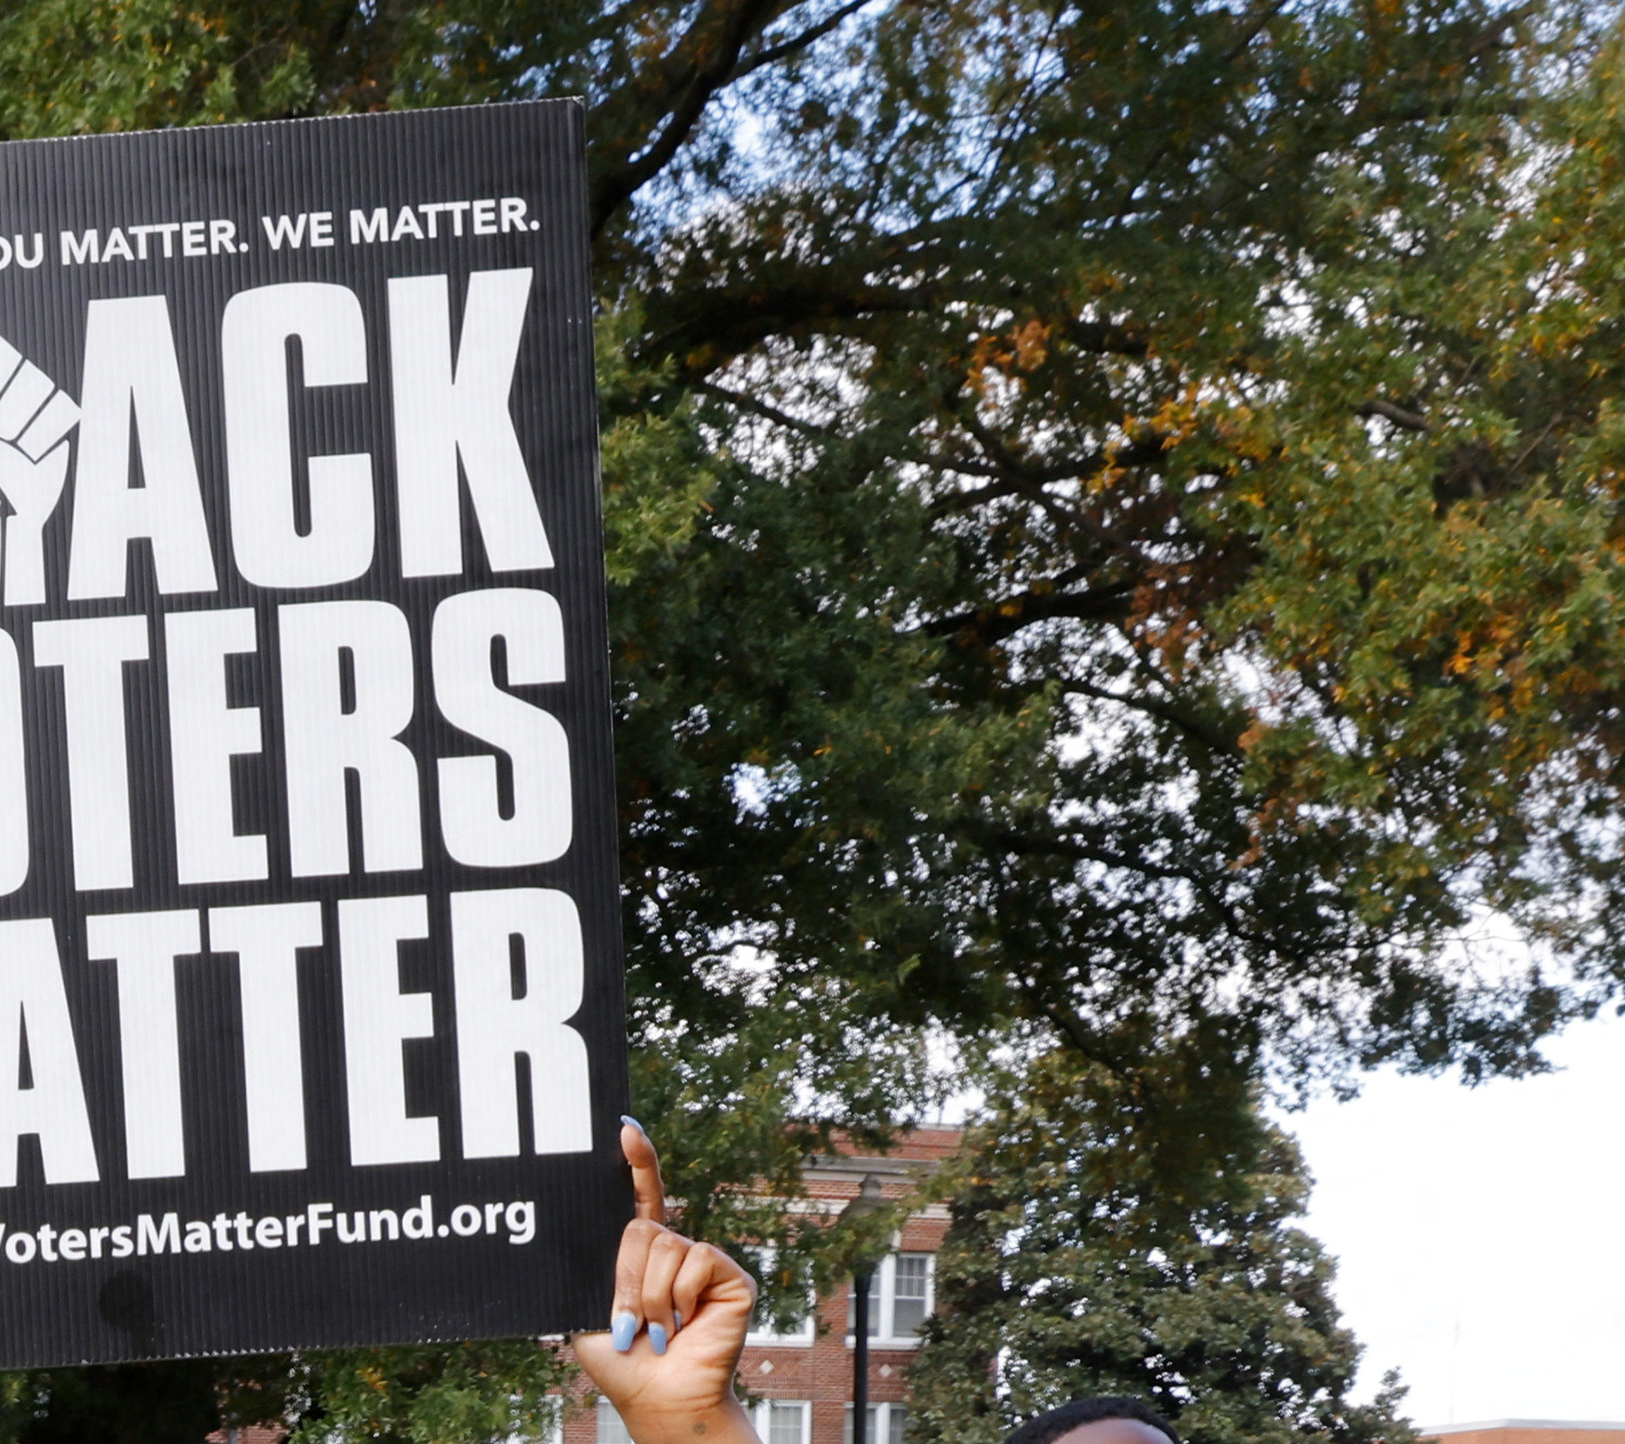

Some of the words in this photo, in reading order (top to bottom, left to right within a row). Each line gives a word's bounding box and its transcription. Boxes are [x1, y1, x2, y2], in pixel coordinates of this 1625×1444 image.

[59, 219, 249, 266] MATTER.
[261, 211, 335, 251] WE
[349, 197, 540, 245] MATTER.
